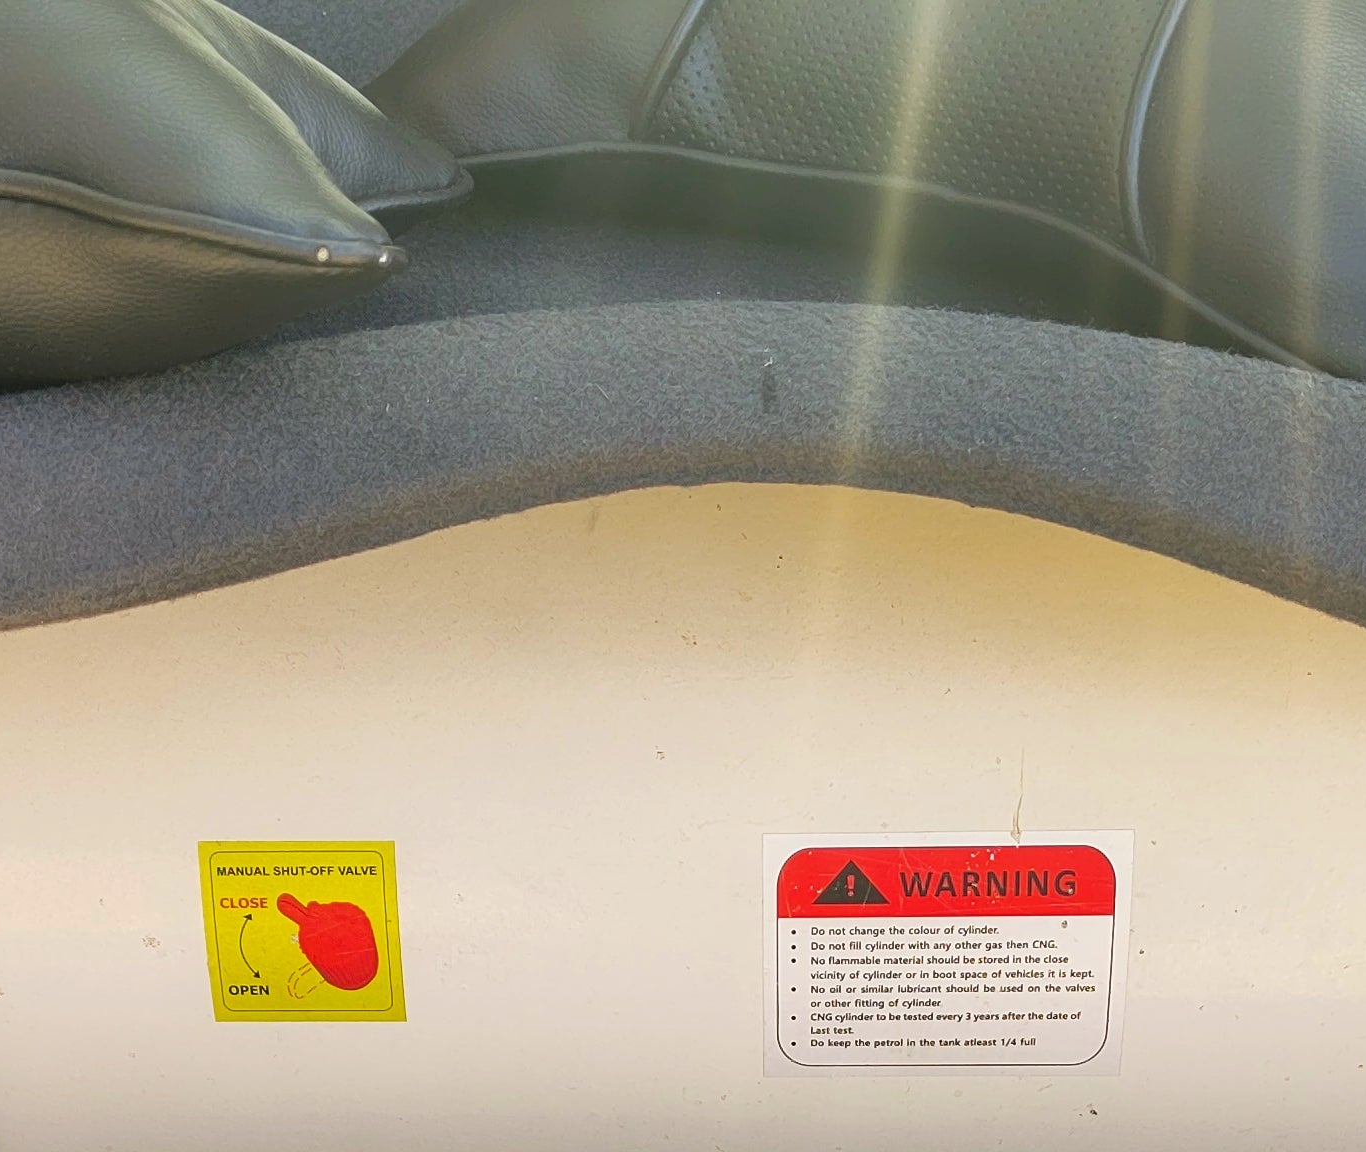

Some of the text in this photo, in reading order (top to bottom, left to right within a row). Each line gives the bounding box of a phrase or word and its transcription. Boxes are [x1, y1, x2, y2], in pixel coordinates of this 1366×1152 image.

[217, 866, 377, 876] MANUAL SHUT-OFF VALVE
[899, 869, 1077, 898] WARNING
[220, 897, 268, 909] CLOSE
[811, 925, 999, 937] Do not change the colour of cylinder.
[811, 940, 1058, 952] Do not fill cylinder with any other gas then CNG.
[811, 955, 1068, 965] No flammable material should be stored in the close
[811, 971, 845, 981] vicinity
[850, 971, 860, 979] of
[863, 971, 902, 981] cylinder
[920, 971, 929, 979] in
[933, 970, 956, 979] boot
[960, 971, 987, 980] space
[991, 970, 1002, 978] of
[1005, 970, 1044, 978] vehicles
[1048, 970, 1055, 978] it
[1059, 970, 1066, 978] is
[1070, 969, 1094, 979] kept.
[228, 985, 269, 996] OPEN
[830, 985, 842, 993] oil
[861, 985, 893, 993] similar
[898, 985, 941, 993] lubricant
[946, 985, 979, 993] should
[1045, 984, 1061, 992] the
[1066, 984, 1095, 992] valves
[855, 999, 885, 1009] fitting
[889, 999, 898, 1007] of
[835, 1013, 873, 1023] cylinder
[889, 1013, 901, 1021] be
[904, 1013, 934, 1021] tested
[936, 1014, 963, 1023] every
[974, 1013, 999, 1022] years
[1002, 1012, 1025, 1020] after
[1028, 1012, 1043, 1020] the
[1046, 1012, 1068, 1020] date
[1071, 1012, 1081, 1020] of
[811, 1039, 824, 1047] Do
[828, 1039, 851, 1048] keep
[855, 1039, 871, 1047] the
[874, 1039, 903, 1048] petrol
[1021, 1038, 1036, 1046] full
